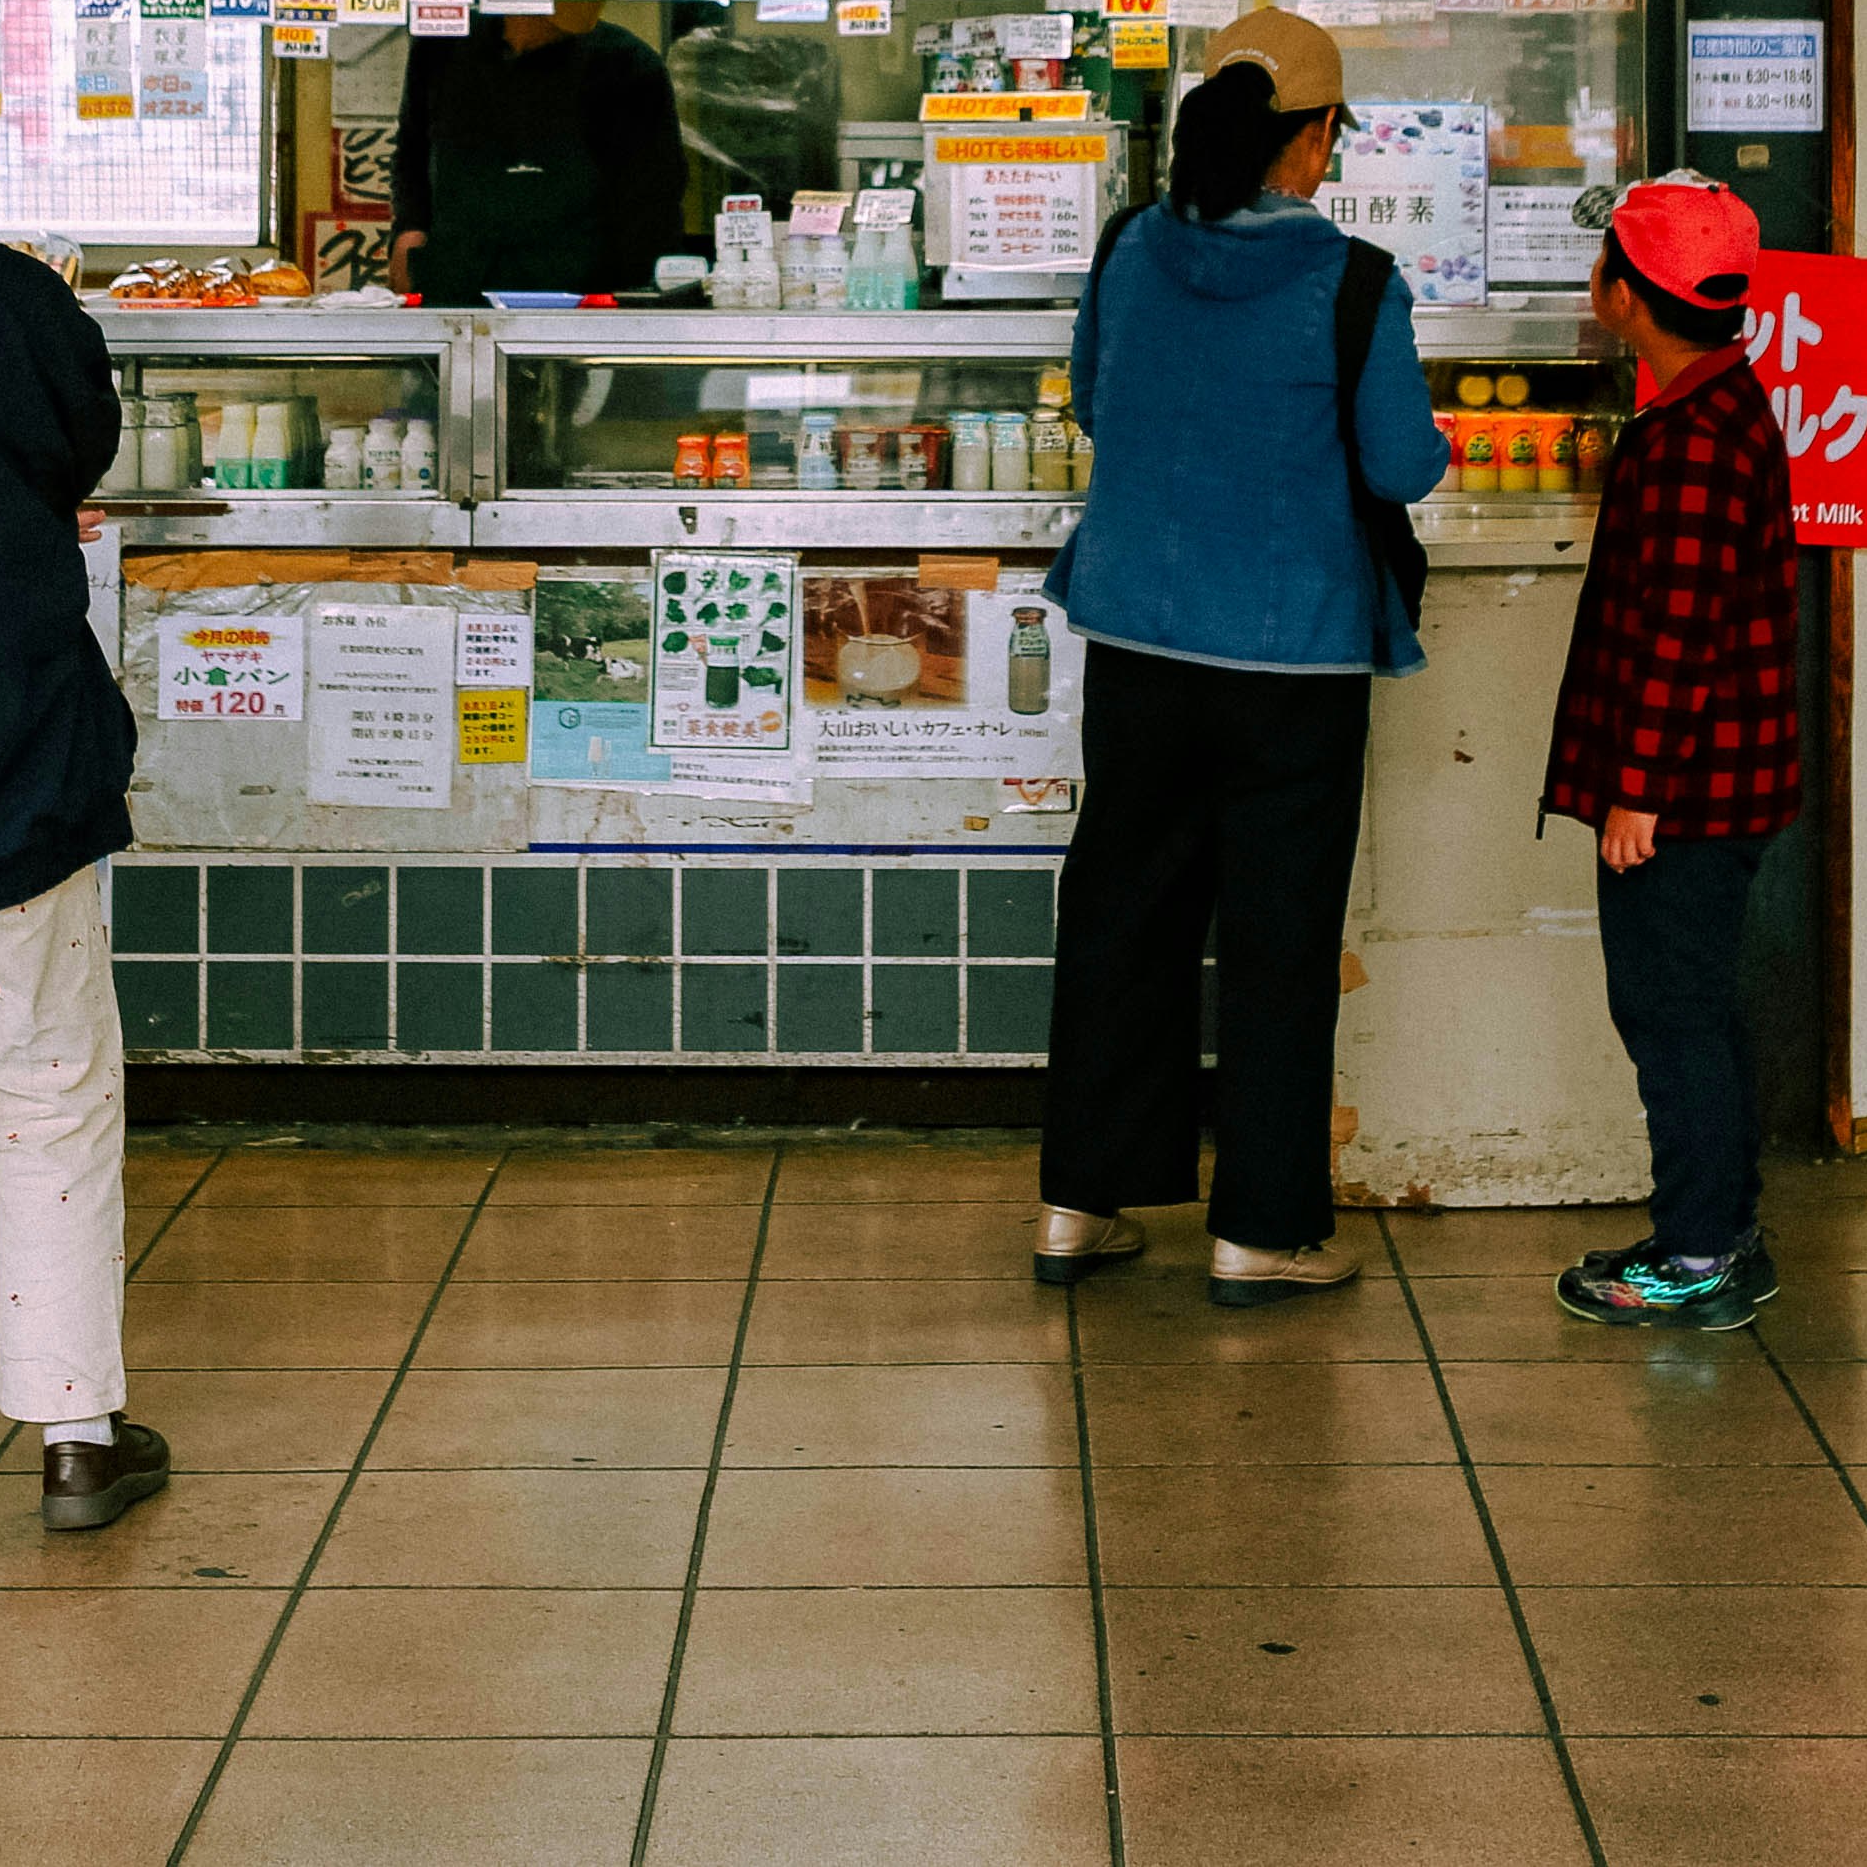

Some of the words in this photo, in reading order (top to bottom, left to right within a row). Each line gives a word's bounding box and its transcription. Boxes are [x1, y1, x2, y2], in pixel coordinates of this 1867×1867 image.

[1815, 504, 1864, 526] Milk
[200, 650, 263, 665] ヤマザキ
[173, 666, 291, 687] 小倉パン
[210, 691, 265, 714] 120
[819, 719, 1014, 739] 大山おいしいカフェ・オ・レ
